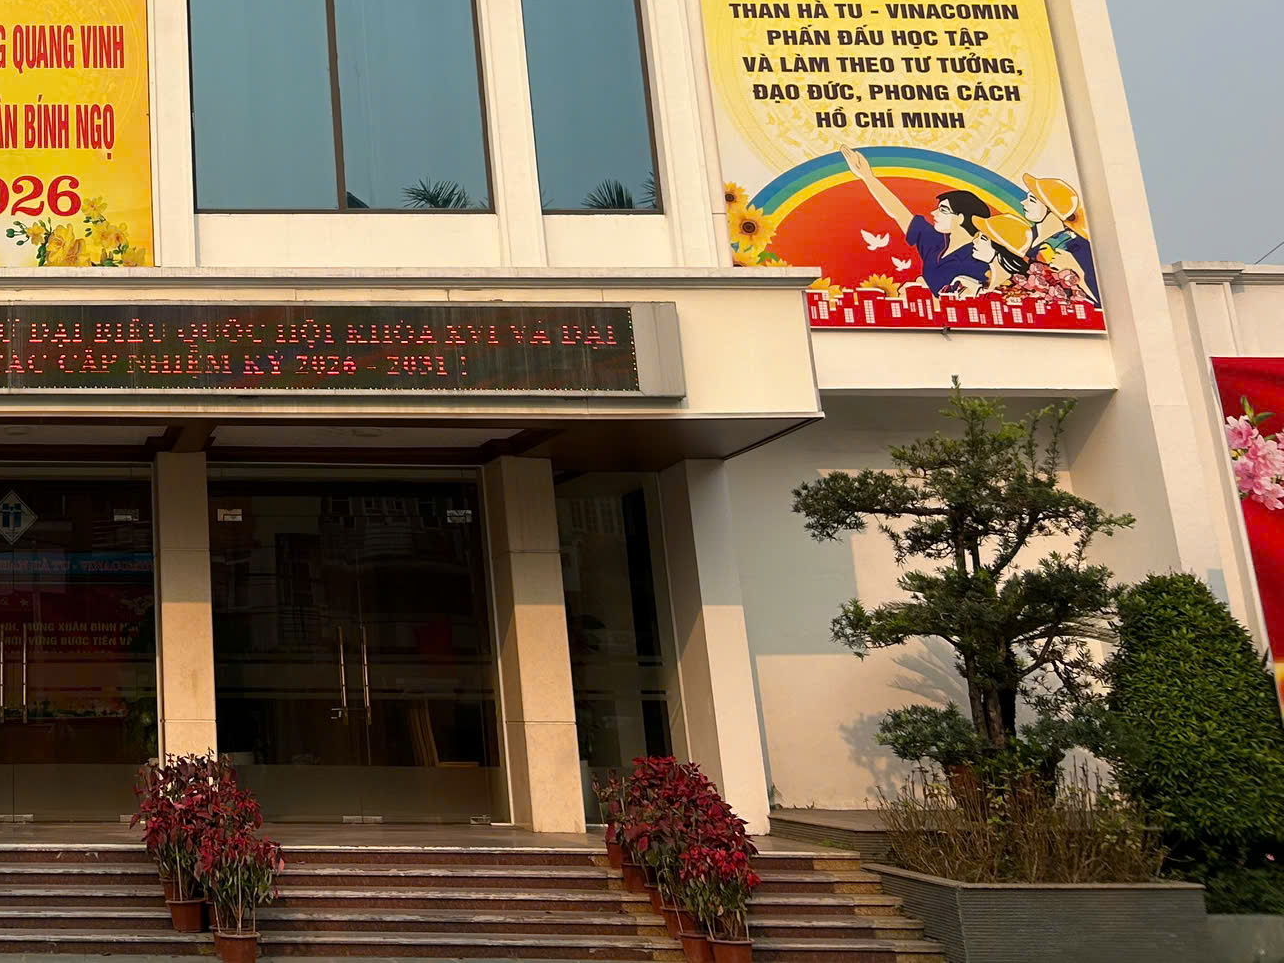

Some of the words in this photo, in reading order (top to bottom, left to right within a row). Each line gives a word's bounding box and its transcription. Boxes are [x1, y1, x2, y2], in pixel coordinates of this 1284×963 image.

[728, 3, 789, 19] THAN
[796, 0, 828, 19] HÀ
[833, 3, 863, 19] TU
[885, 3, 1020, 20] VINACOMIN
[767, 24, 831, 46] PHẤN
[837, 24, 884, 46] ĐẤU
[892, 29, 938, 49] HỌC
[944, 26, 989, 49] TẬP
[12, 24, 75, 74] QUANG
[80, 25, 125, 69] VINH
[742, 53, 774, 72] VÀ
[780, 53, 830, 73] LÀM
[836, 56, 894, 73] THEO
[901, 55, 932, 73] TƯ
[936, 52, 1023, 76] TƯỞNG,
[753, 83, 800, 104] ĐẠO
[807, 80, 862, 103] ĐỨC,
[868, 84, 949, 101] PHONG
[957, 82, 1021, 102] CÁCH
[24, 94, 69, 149] BÍNH
[76, 103, 115, 160] NGỌ
[816, 106, 847, 129] HỒ
[854, 109, 895, 128] CHÍ
[901, 111, 966, 129] MINH
[295, 355, 357, 375] 2026
